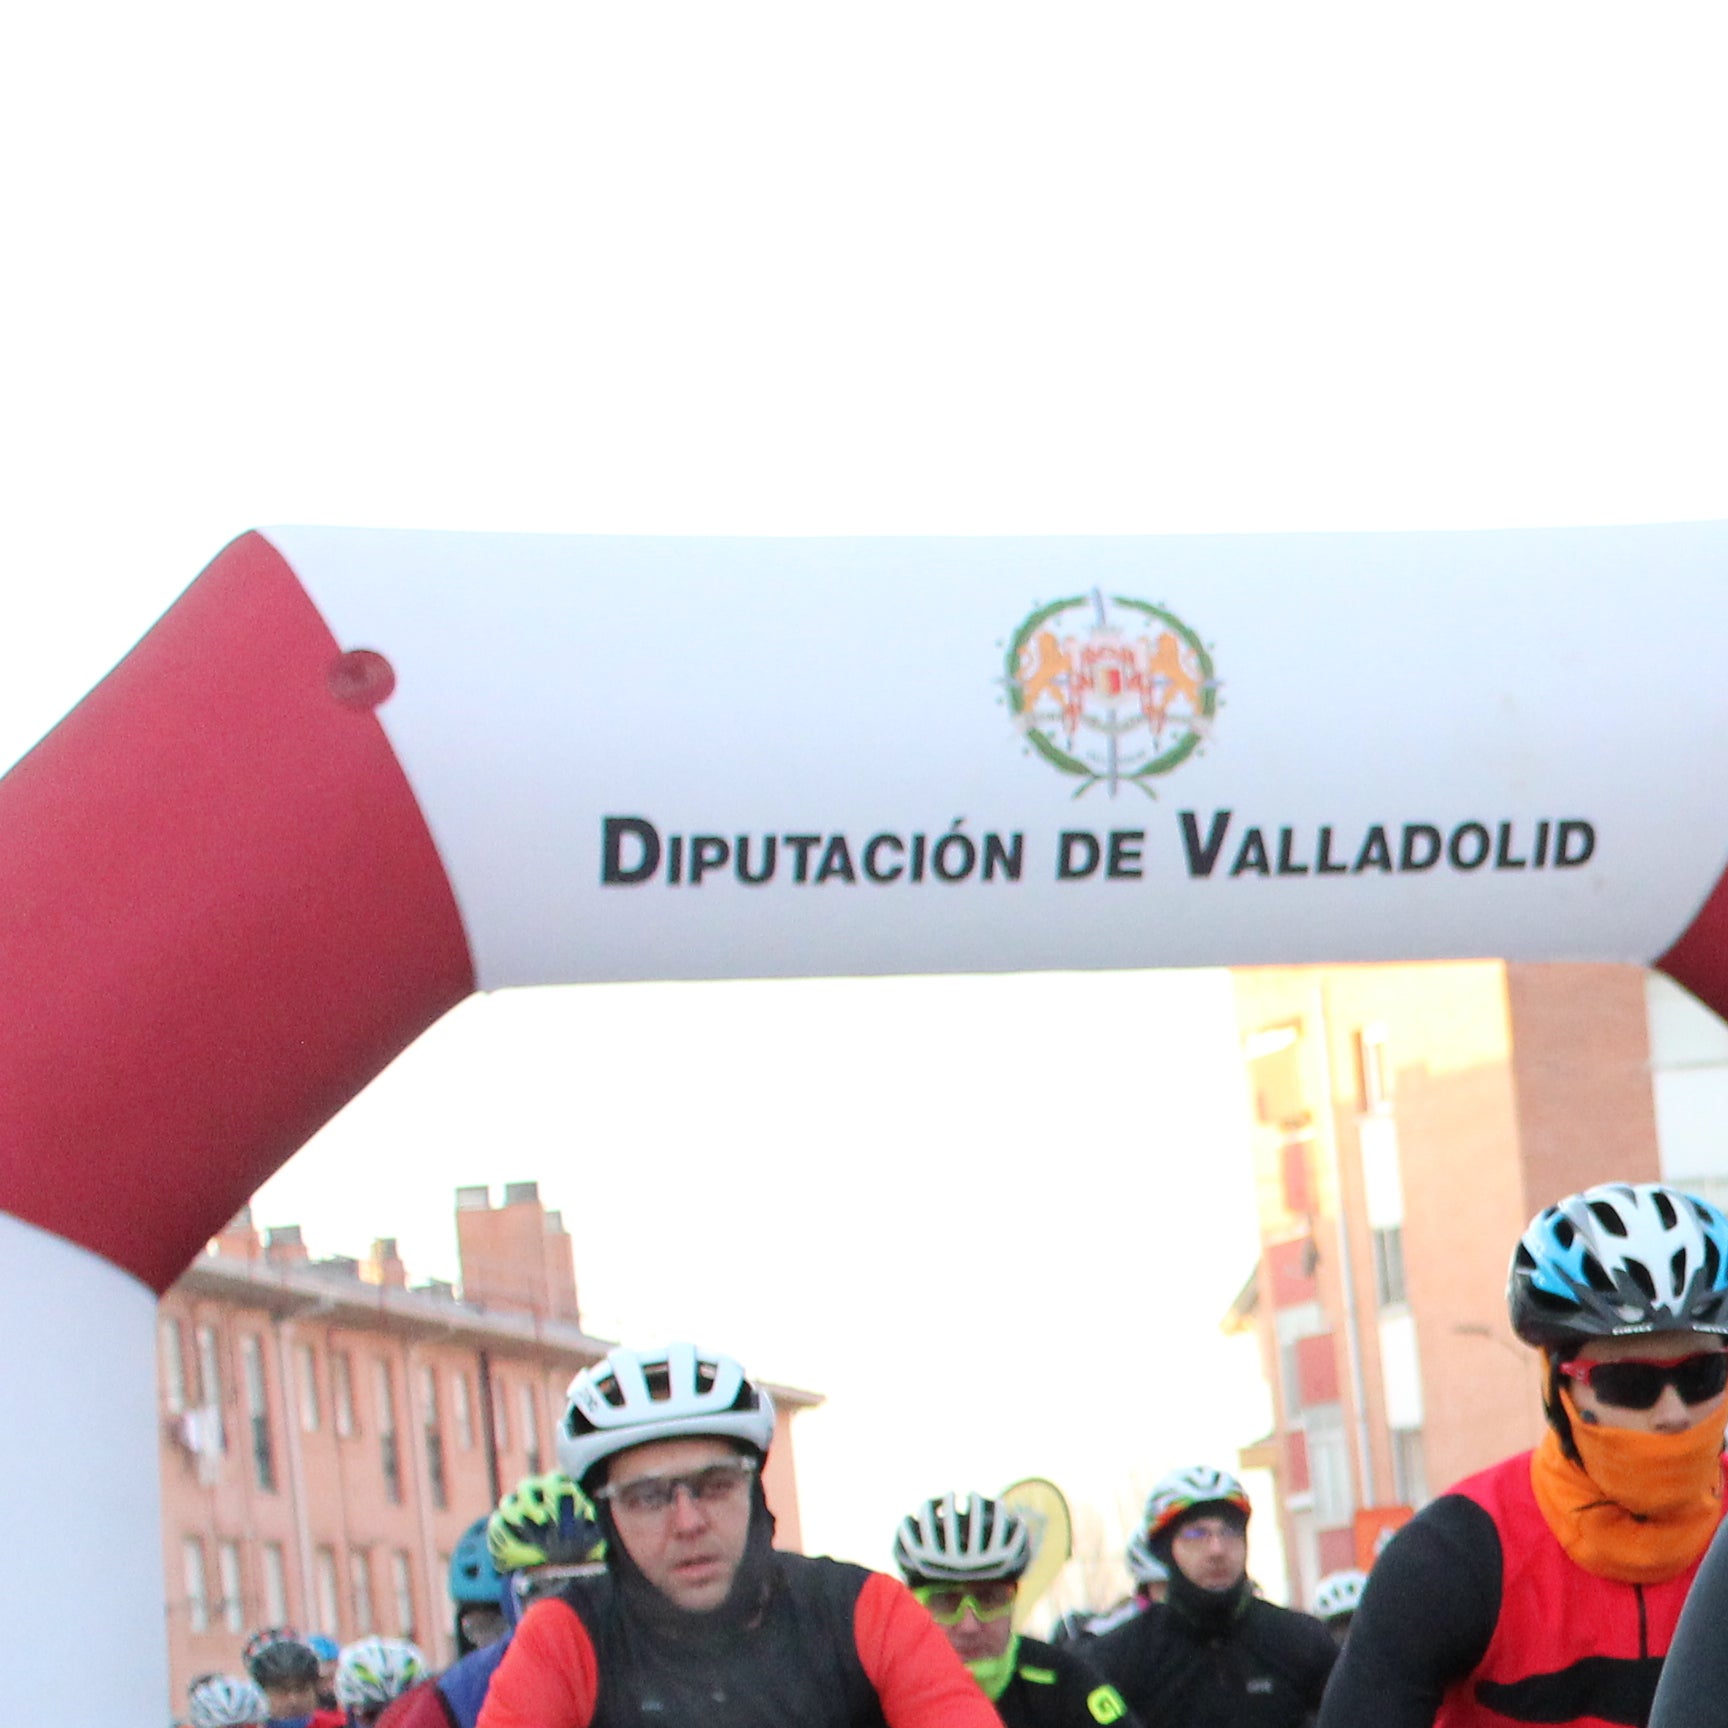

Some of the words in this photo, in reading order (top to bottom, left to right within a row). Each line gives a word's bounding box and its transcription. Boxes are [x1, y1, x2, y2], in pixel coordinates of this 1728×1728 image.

[600, 815, 1025, 886] DIPUTACIÓN
[1056, 829, 1144, 880] DE
[1178, 809, 1597, 879] VALLADOLID
